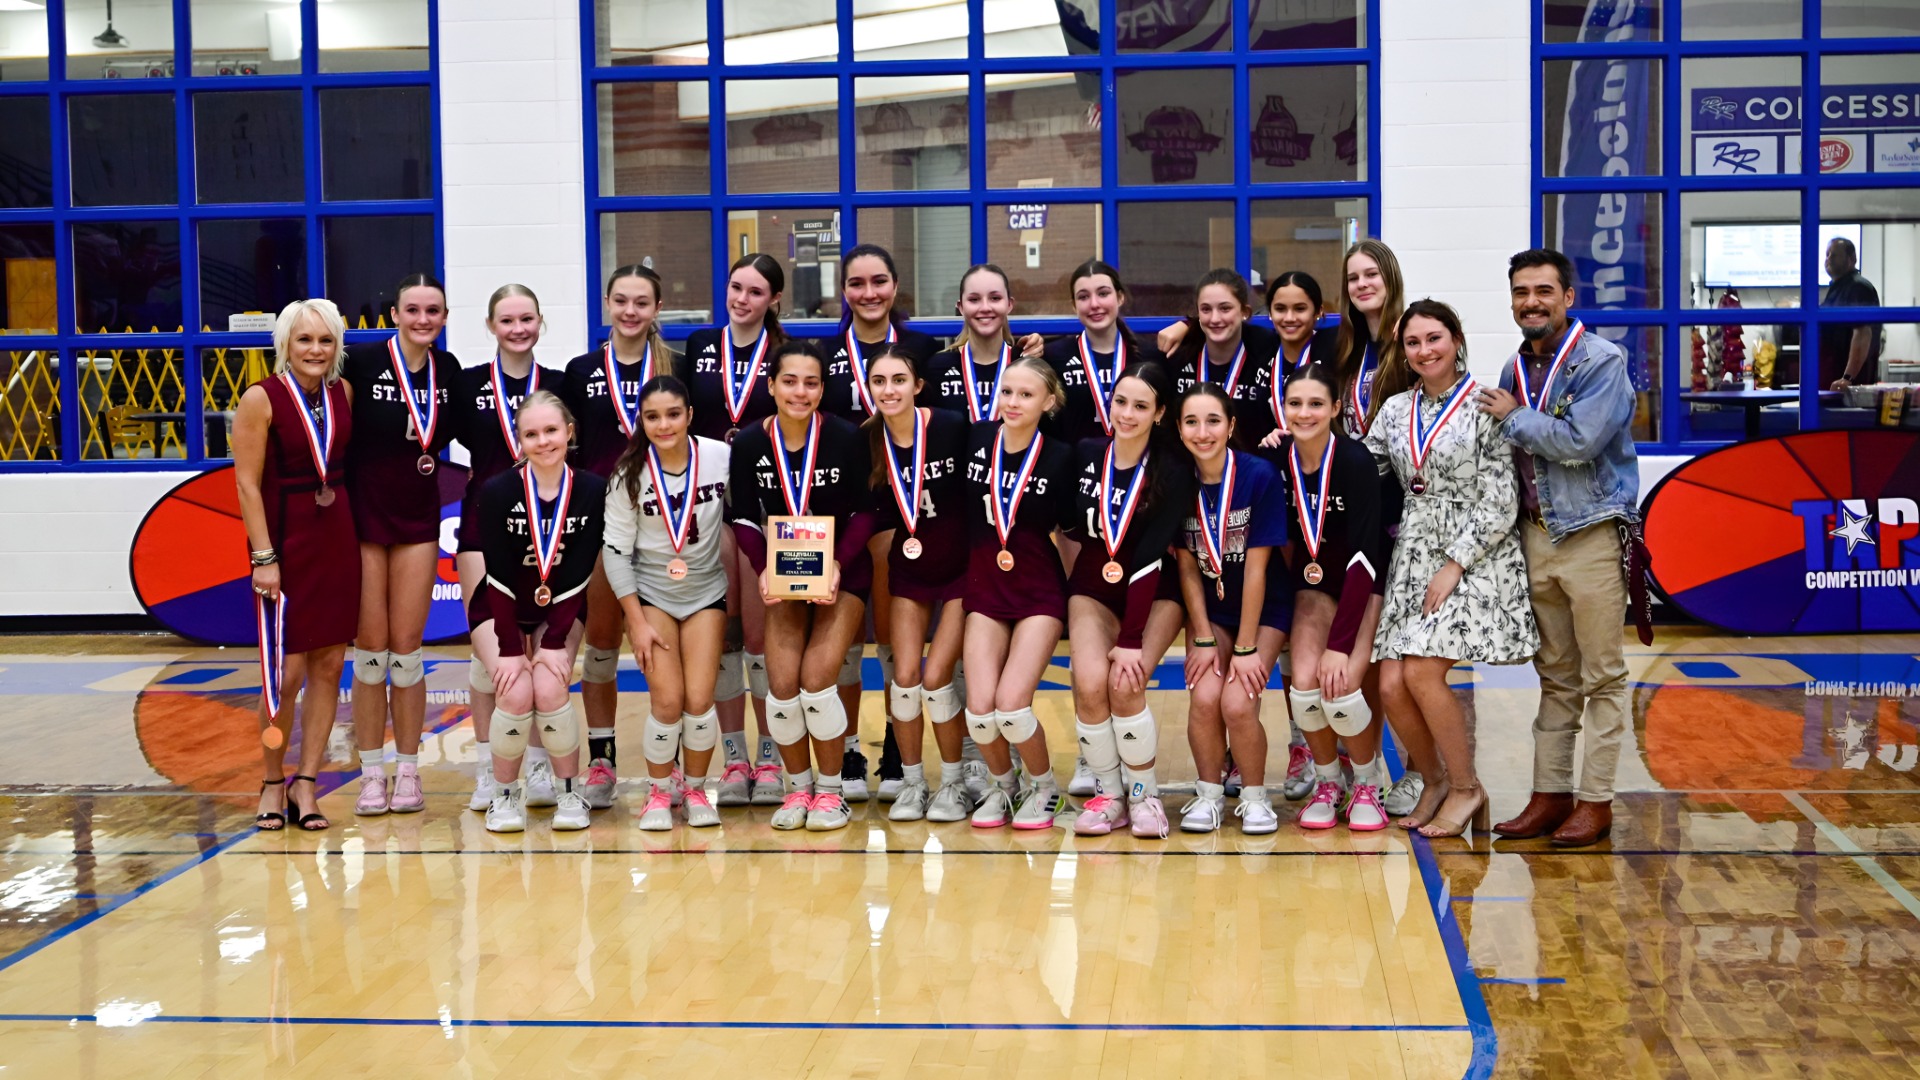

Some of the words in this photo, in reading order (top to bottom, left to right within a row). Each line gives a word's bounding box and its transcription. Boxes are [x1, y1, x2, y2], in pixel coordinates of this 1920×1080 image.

[1745, 93, 1920, 121] COCESSI
[1009, 213, 1043, 229] CAFE
[696, 357, 716, 373] ST.
[829, 360, 849, 375] ST.
[1062, 369, 1087, 386] ST.
[372, 384, 398, 402] ST.
[586, 381, 607, 398] ST.
[940, 380, 964, 396] ST.
[475, 395, 495, 410] ST
[966, 461, 984, 483] ST.
[506, 517, 528, 536] ST.
[774, 521, 827, 540] TAPPS
[1806, 570, 1907, 590] COMPETITION
